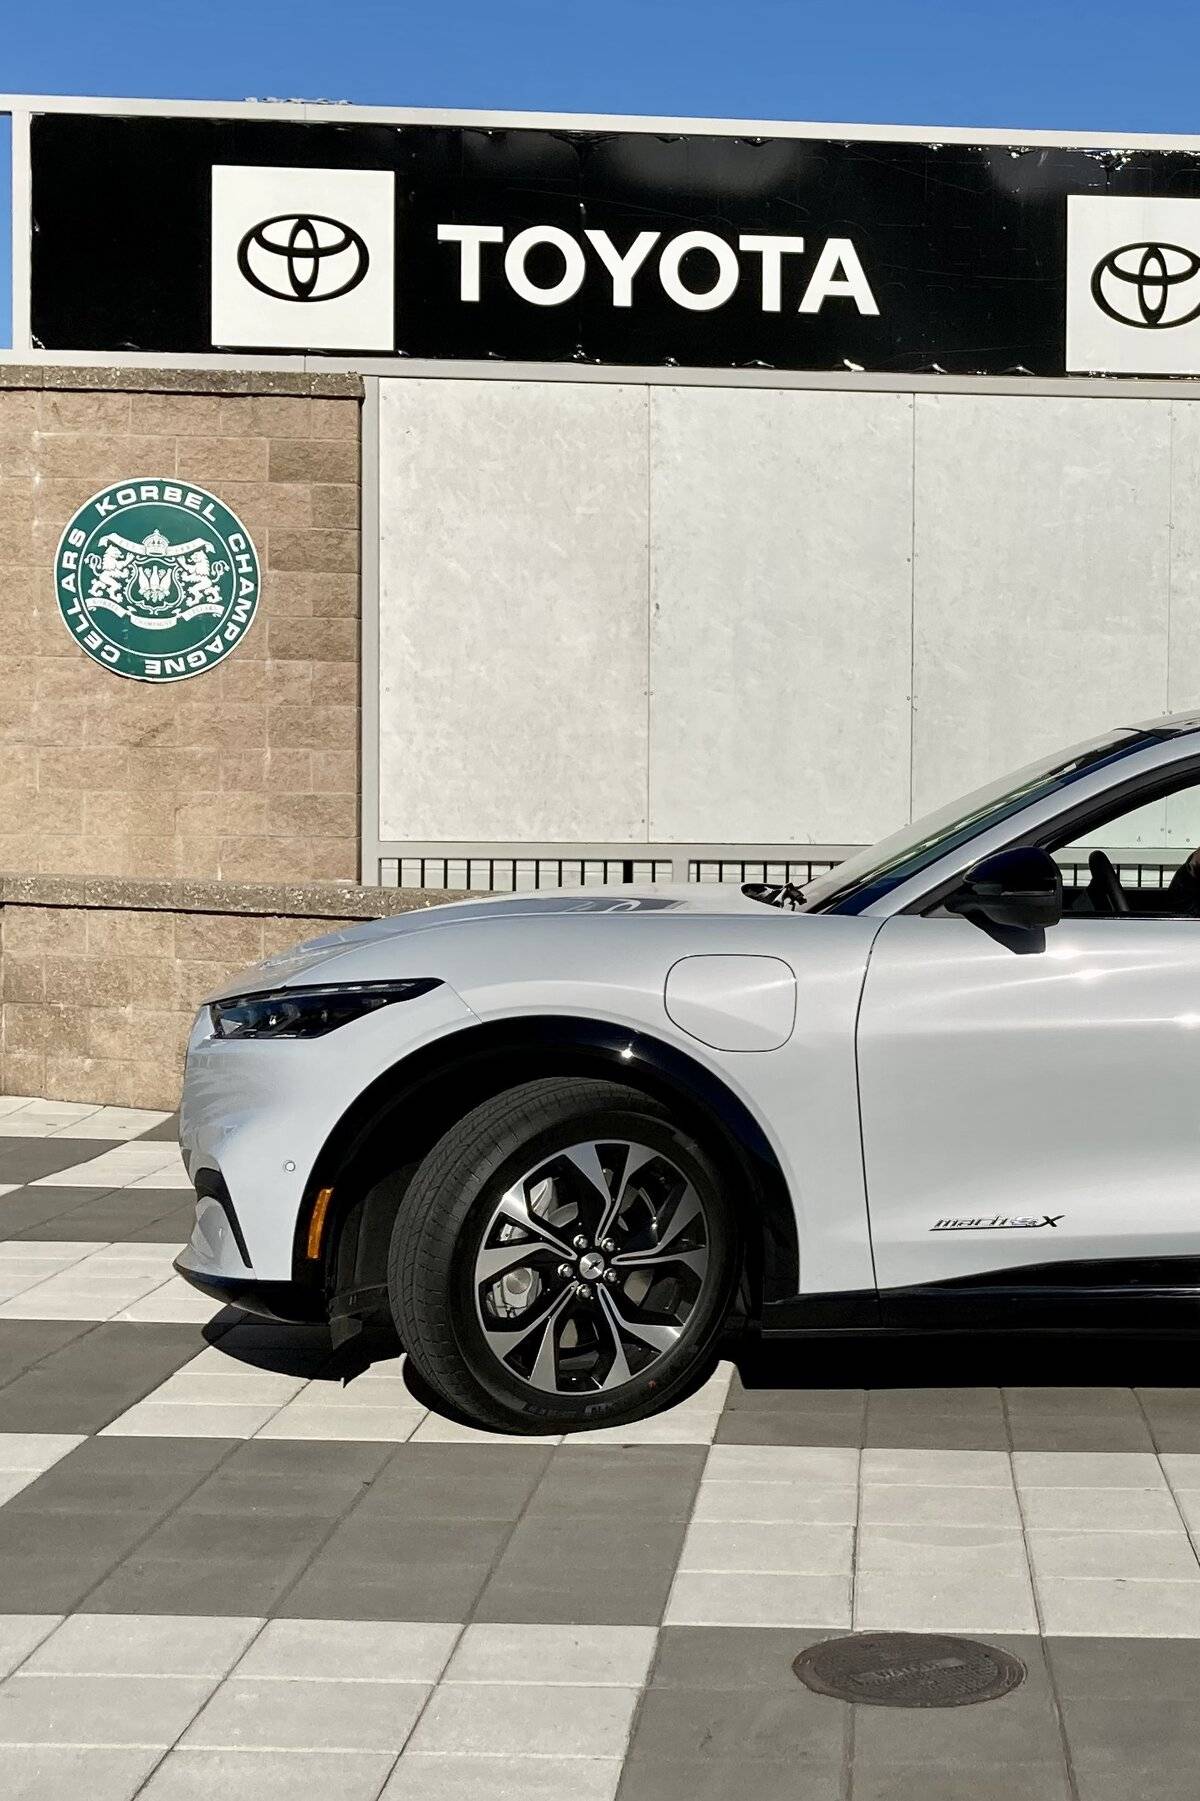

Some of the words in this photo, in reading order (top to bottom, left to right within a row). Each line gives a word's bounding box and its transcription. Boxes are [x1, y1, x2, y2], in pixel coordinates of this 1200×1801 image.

[437, 223, 881, 316] TOYOTA
[94, 485, 217, 523] KORBEL
[61, 527, 122, 664] CELLARS
[144, 532, 255, 675] CHAMPAGNE
